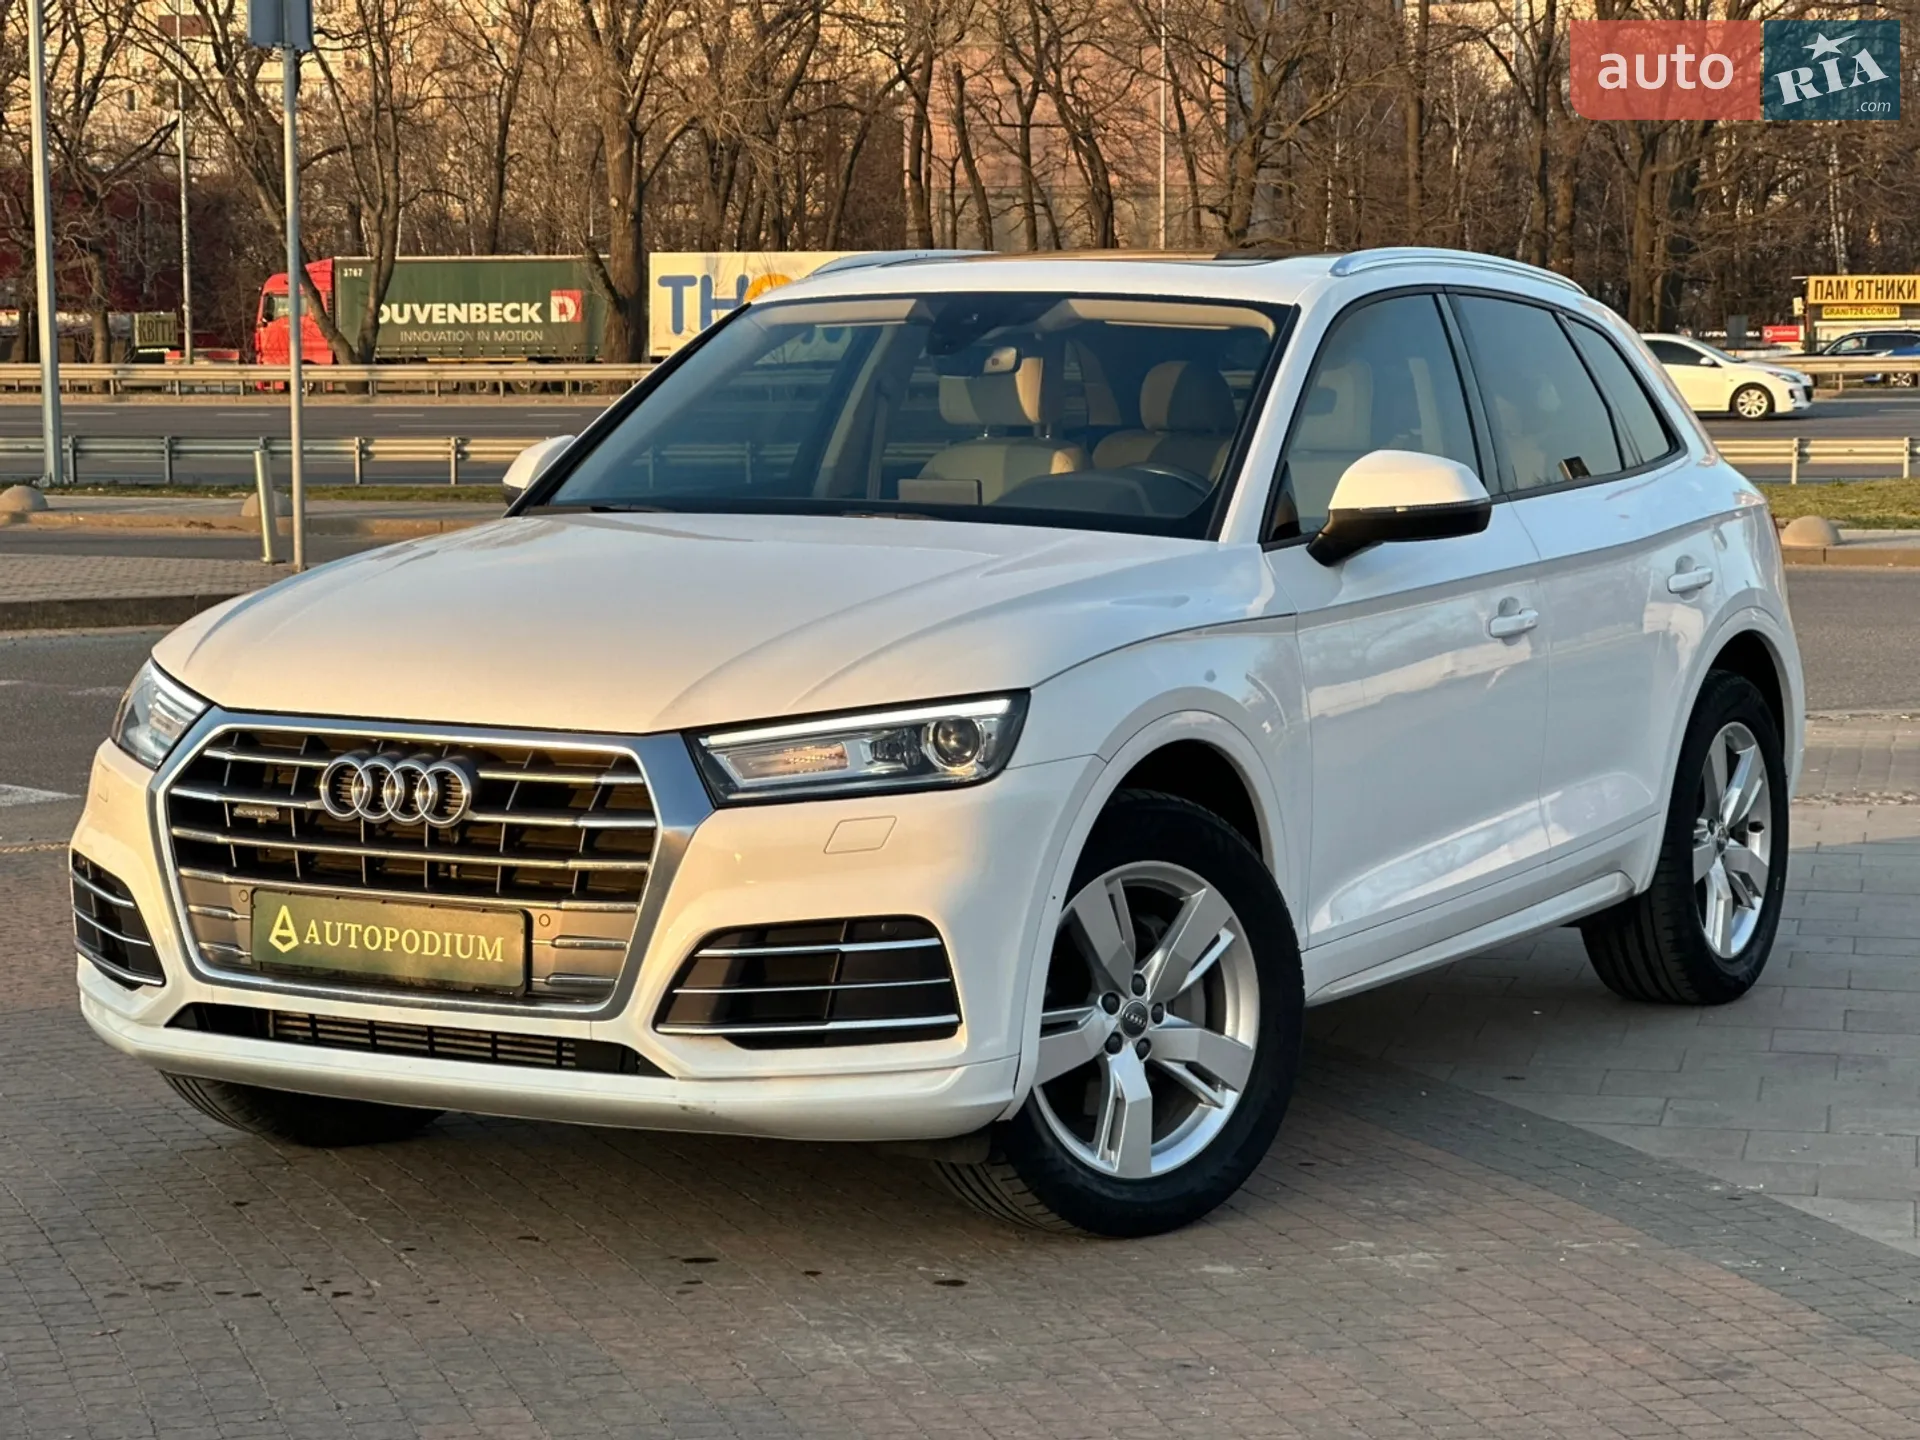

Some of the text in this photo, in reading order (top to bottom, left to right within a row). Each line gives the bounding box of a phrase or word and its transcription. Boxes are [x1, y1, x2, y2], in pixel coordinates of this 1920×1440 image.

[1814, 279, 1917, 300] ПАМ'ЯТНИКИ
[1823, 306, 1898, 316] GRANIT24.COM.UA
[400, 330, 544, 342] INNOVATION IN MOTION
[304, 919, 504, 962] AUTOPODIUM
